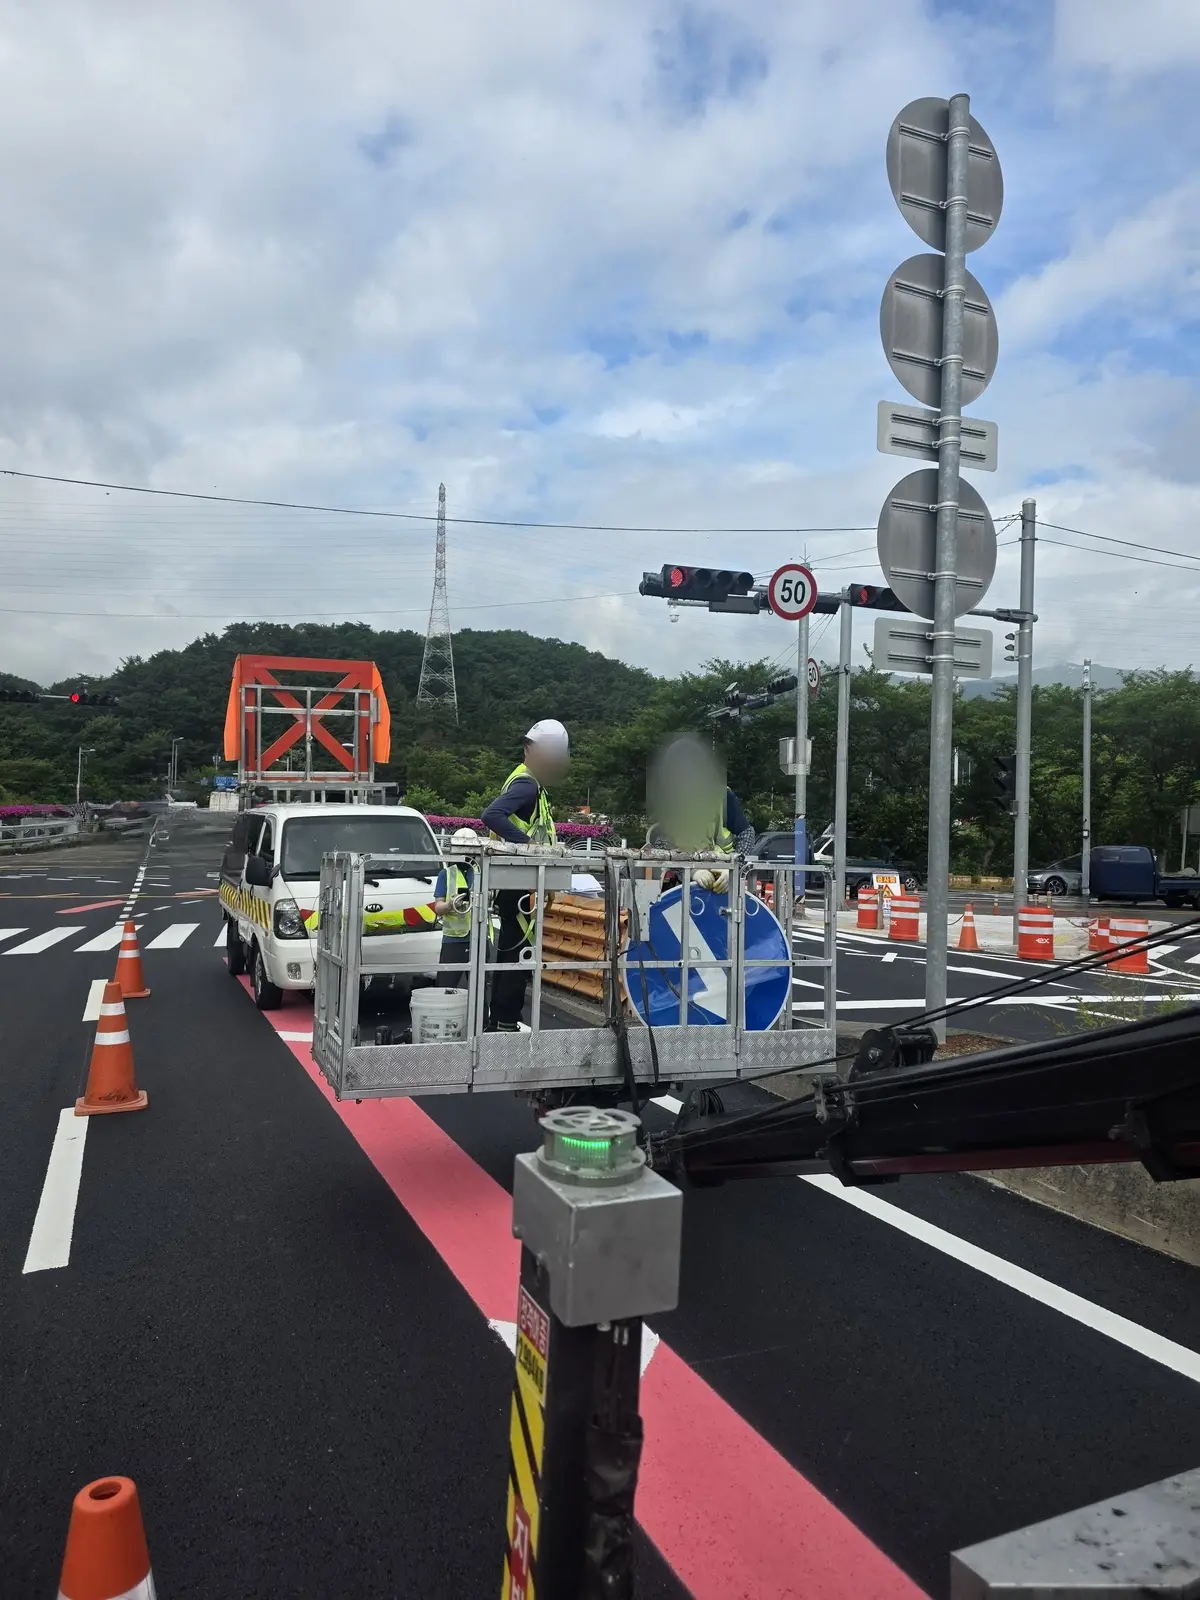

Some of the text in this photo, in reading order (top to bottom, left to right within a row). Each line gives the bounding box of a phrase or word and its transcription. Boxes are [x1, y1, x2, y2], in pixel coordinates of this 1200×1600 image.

[780, 579, 806, 605] 50
[808, 667, 817, 683] 50
[366, 903, 381, 911] KIA
